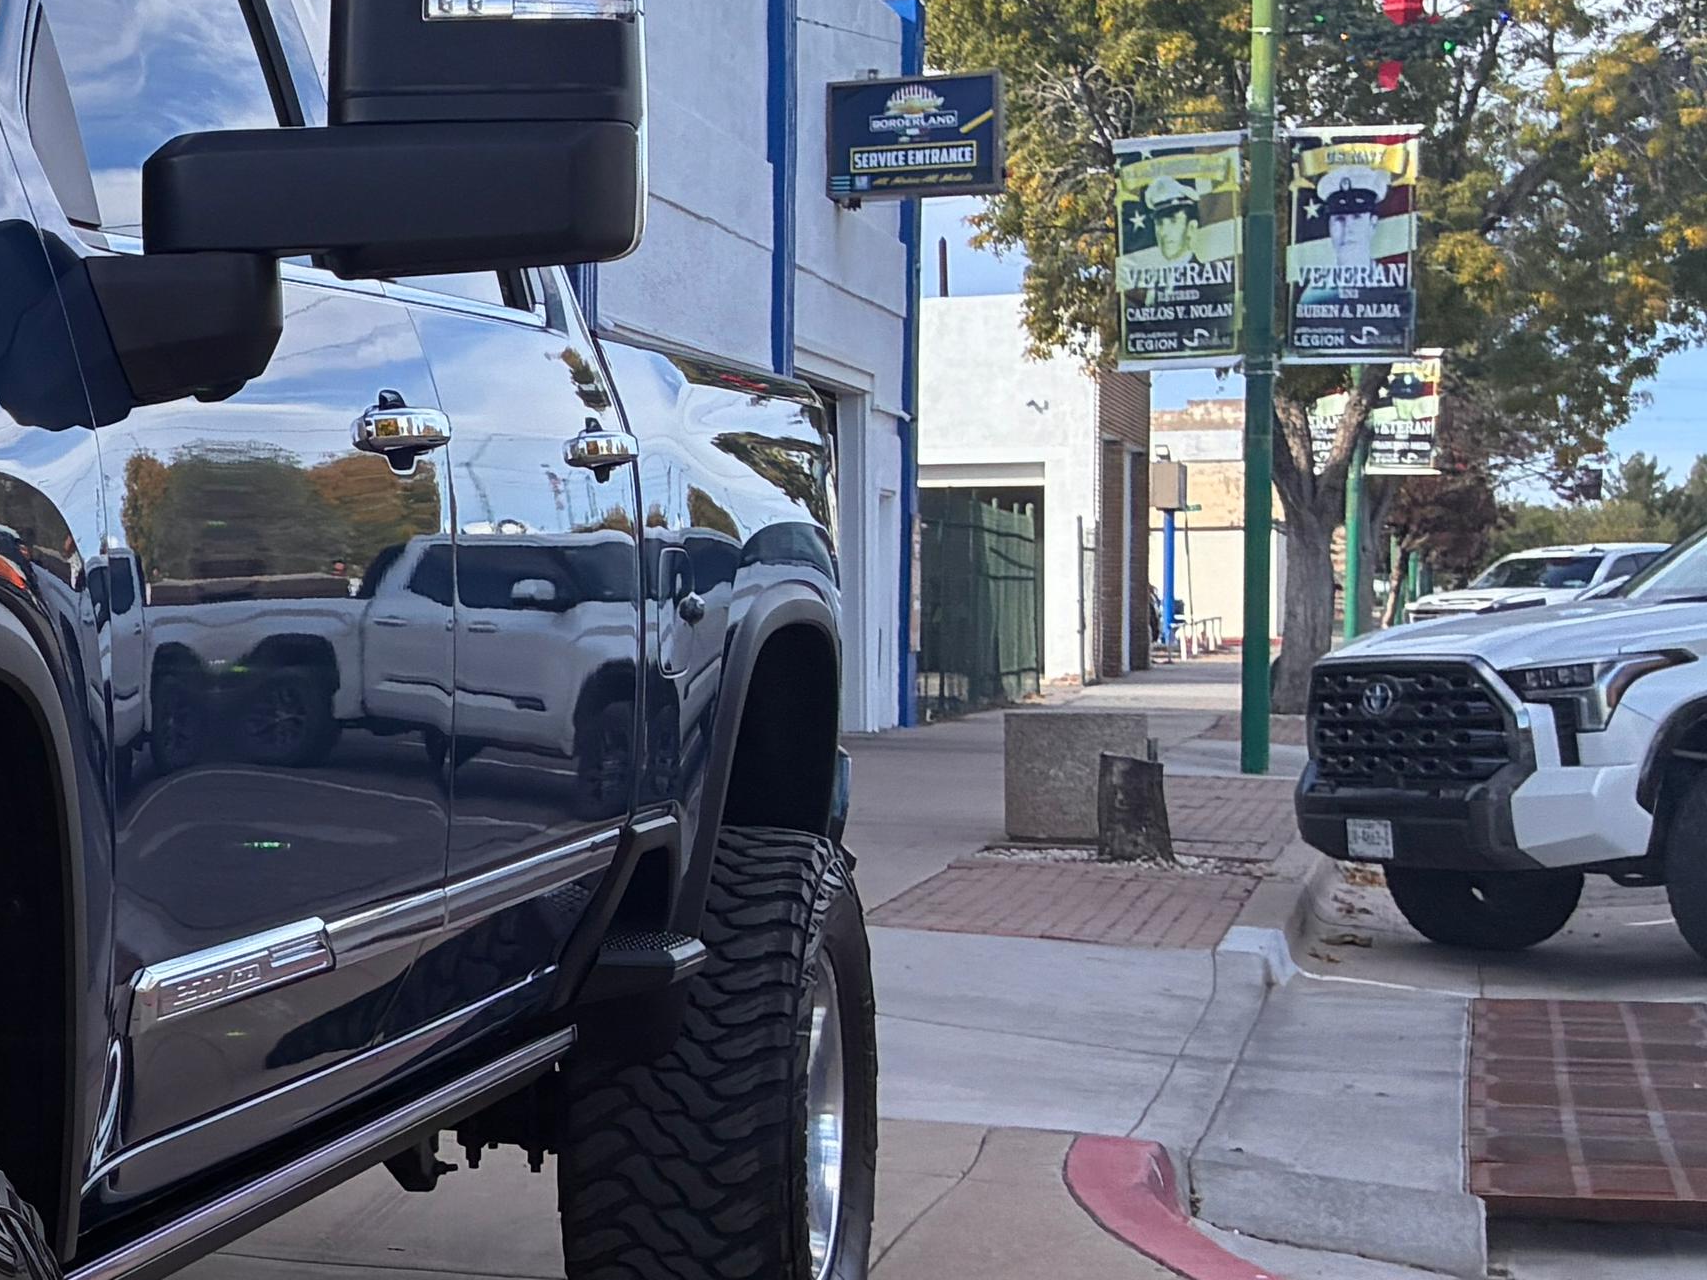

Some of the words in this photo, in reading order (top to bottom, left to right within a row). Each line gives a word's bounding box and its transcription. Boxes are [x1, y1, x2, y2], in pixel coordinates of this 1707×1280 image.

[872, 114, 956, 129] BORDERLAND
[854, 150, 905, 168] SERVICE
[907, 147, 973, 165] ENTRANCE
[1125, 261, 1234, 288] VETERAN
[1297, 261, 1406, 288] VETERAN
[1127, 306, 1175, 321] CARLOS
[1190, 303, 1233, 319] NOLAN
[1296, 304, 1340, 318] RUBEN
[1356, 304, 1401, 318] PALMA
[1128, 339, 1177, 352] LEGION
[1294, 334, 1345, 347] LEGION
[1373, 420, 1433, 435] VETERAN
